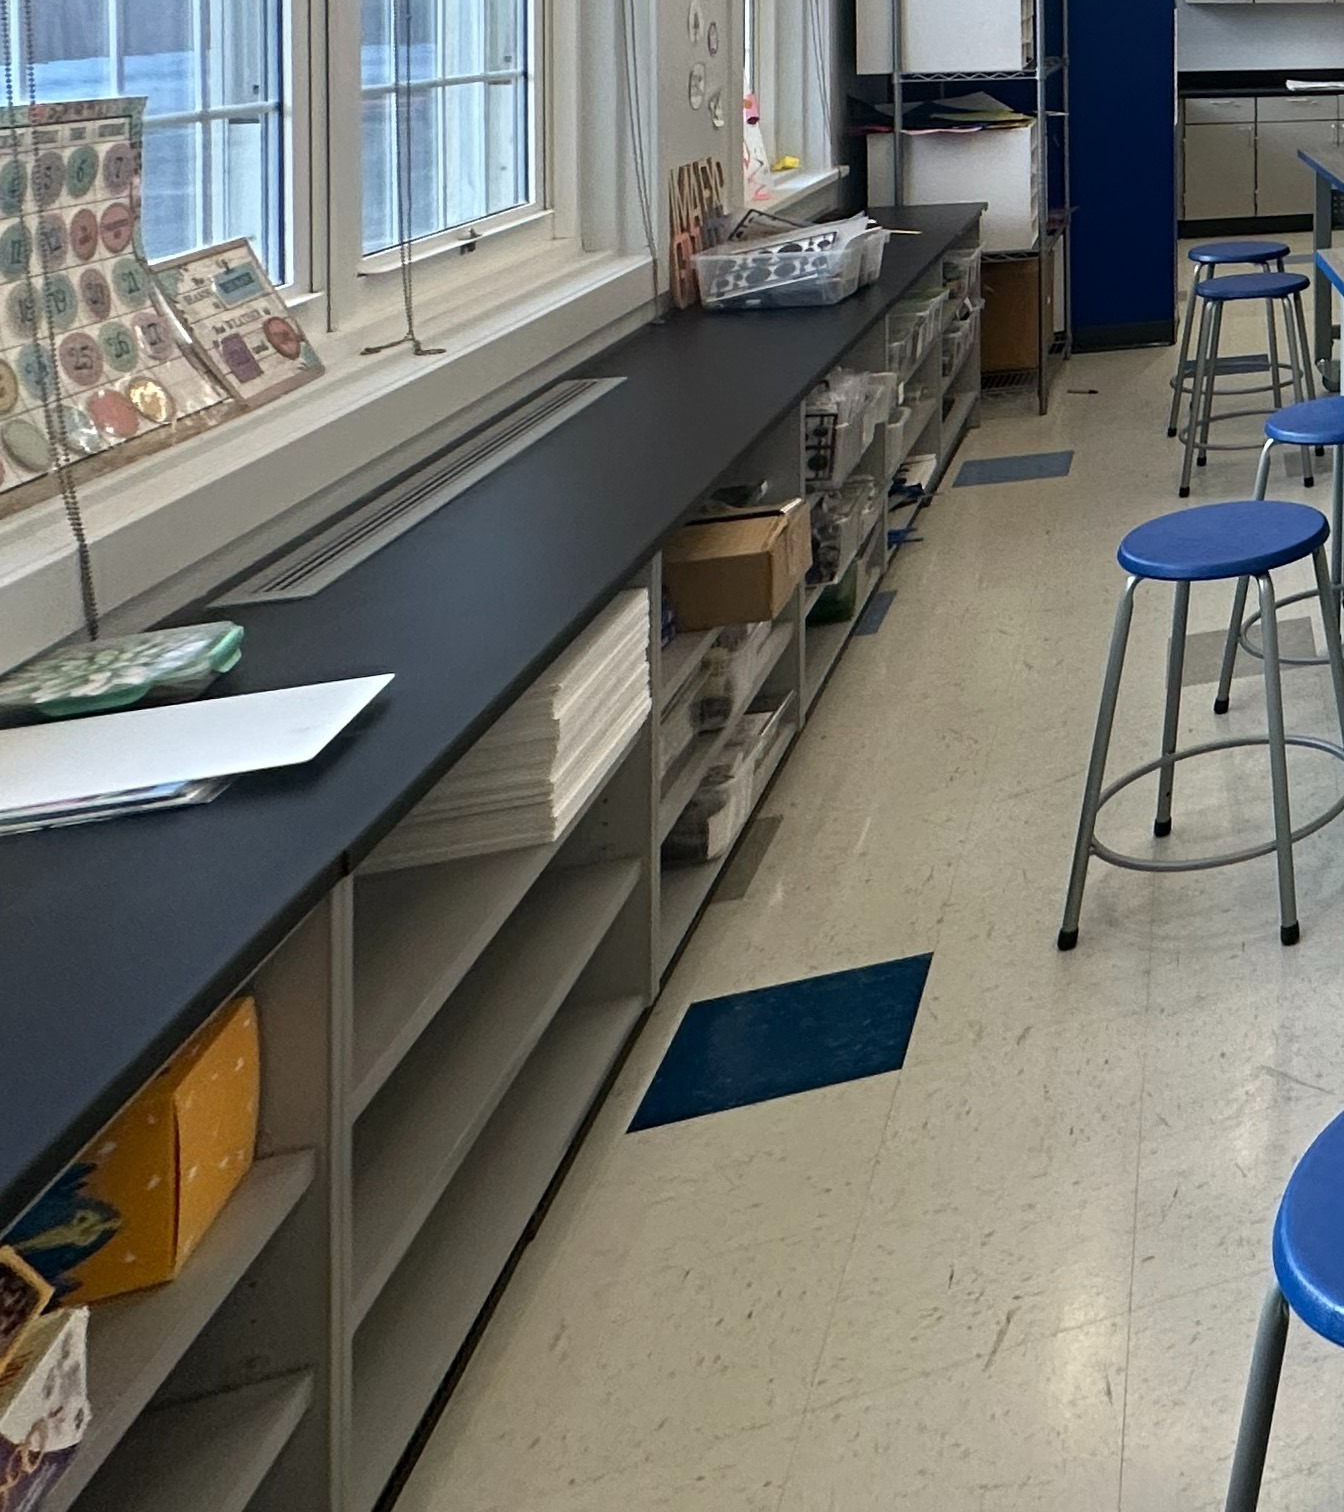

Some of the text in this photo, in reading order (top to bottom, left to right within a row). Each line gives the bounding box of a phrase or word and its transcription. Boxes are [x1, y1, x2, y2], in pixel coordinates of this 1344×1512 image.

[76, 159, 88, 183] 6
[114, 156, 124, 180] 7
[68, 344, 95, 371] 25
